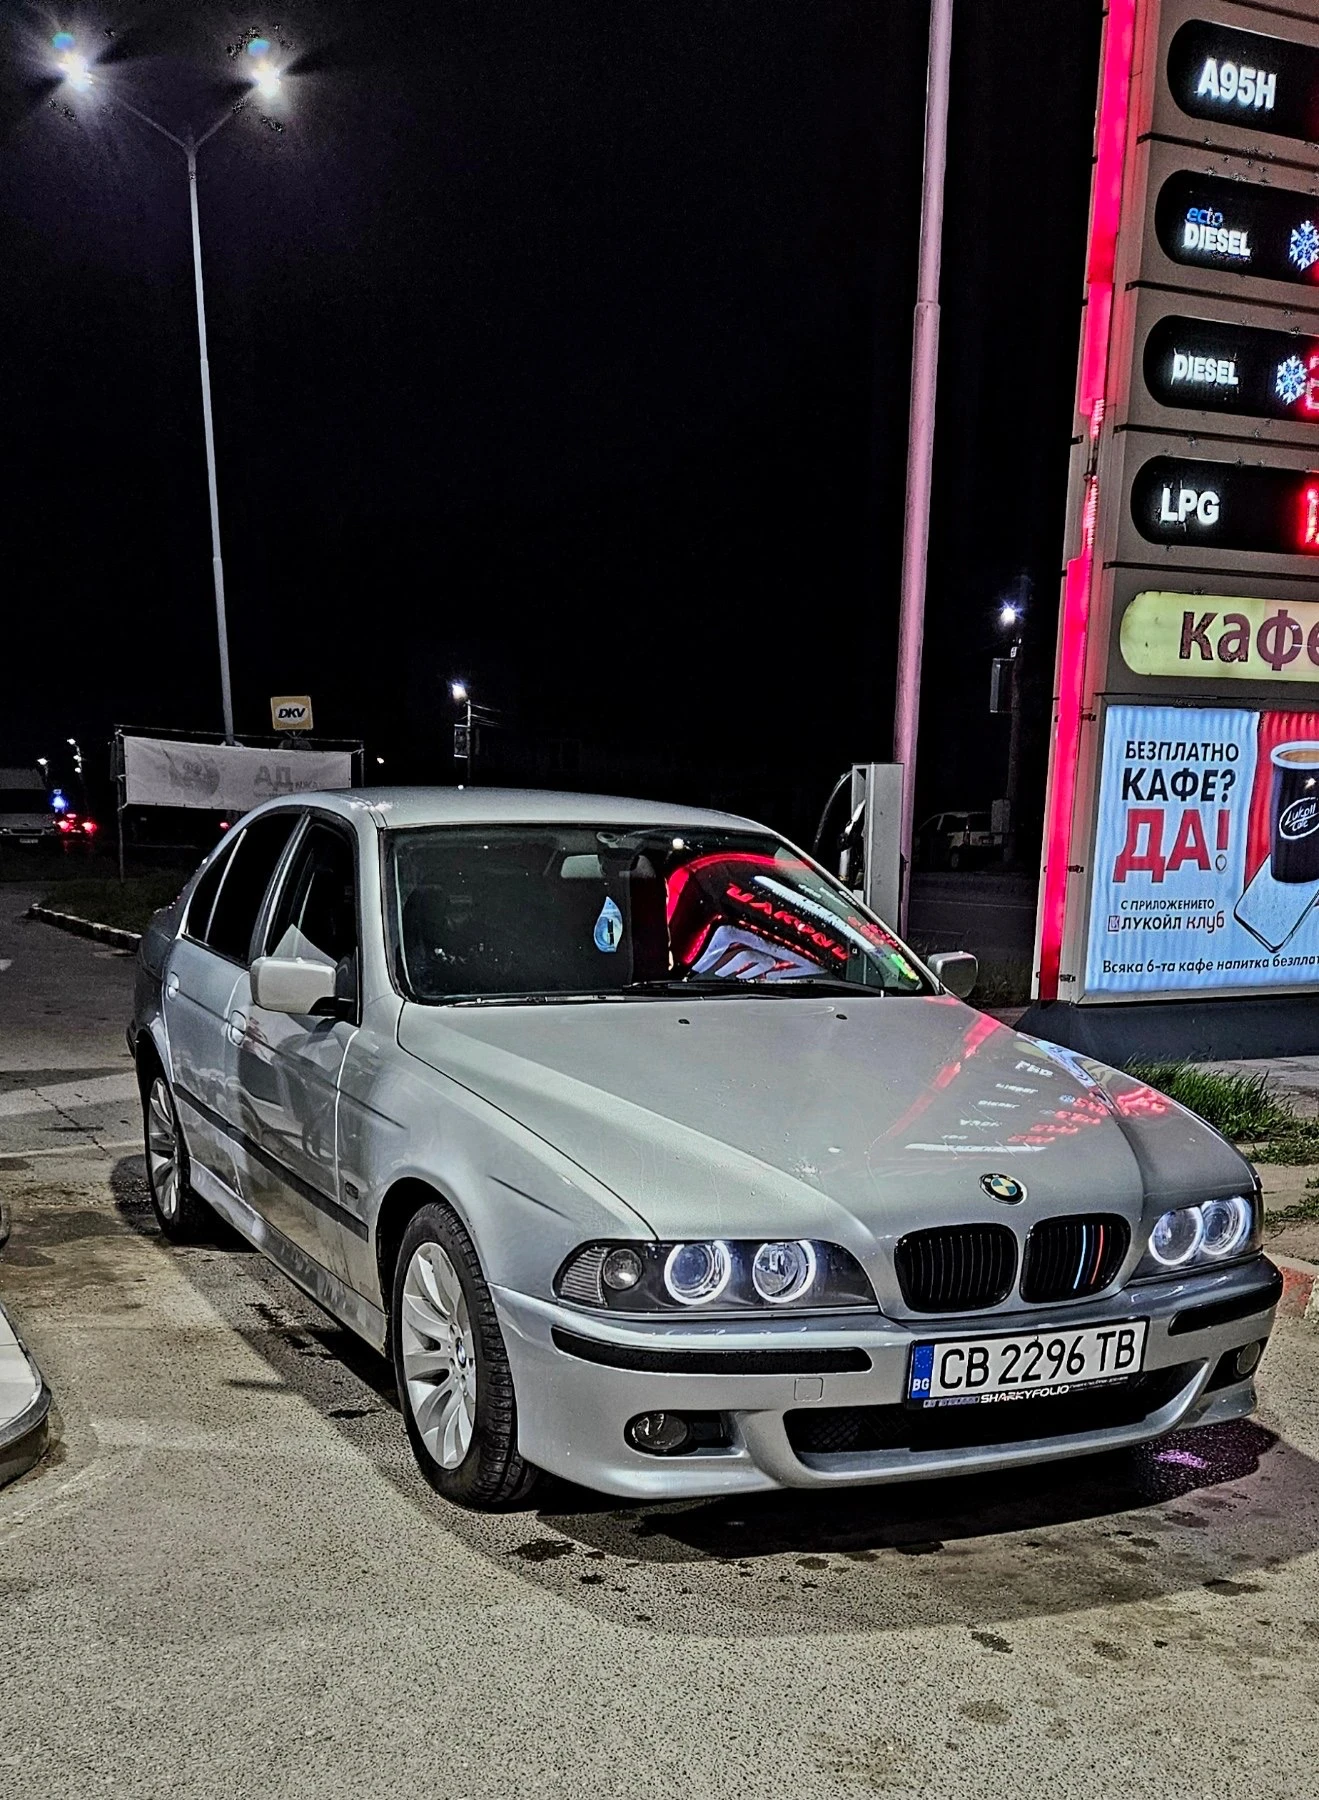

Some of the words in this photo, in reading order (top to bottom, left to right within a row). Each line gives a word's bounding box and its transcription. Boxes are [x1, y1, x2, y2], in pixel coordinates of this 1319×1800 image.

[1197, 58, 1277, 111] A95H
[1187, 207, 1223, 226] ecto
[1183, 221, 1251, 256] DIESEL
[1172, 354, 1239, 385] DIESEL
[1160, 487, 1220, 525] LPG
[278, 707, 306, 719] DKV
[1125, 740, 1239, 762] БЕЗПЛАТНО
[1122, 767, 1236, 803] КАФЕ?
[1112, 808, 1231, 883] ДА!
[1131, 899, 1215, 910] ПРИЛОЖЕНИЕТО
[1121, 914, 1181, 929] ЛУКОЙЛ
[1186, 910, 1225, 934] клуб
[1103, 960, 1143, 973] Всяка
[1147, 960, 1175, 972] 6-та
[1179, 958, 1213, 974] кафе
[1217, 958, 1269, 971] напитка
[940, 1347, 989, 1390] CB
[998, 1336, 1085, 1385] 2296
[1097, 1329, 1135, 1372] TB
[912, 1378, 930, 1391] BG
[981, 1384, 1070, 1404] SHARKYFOLIO
